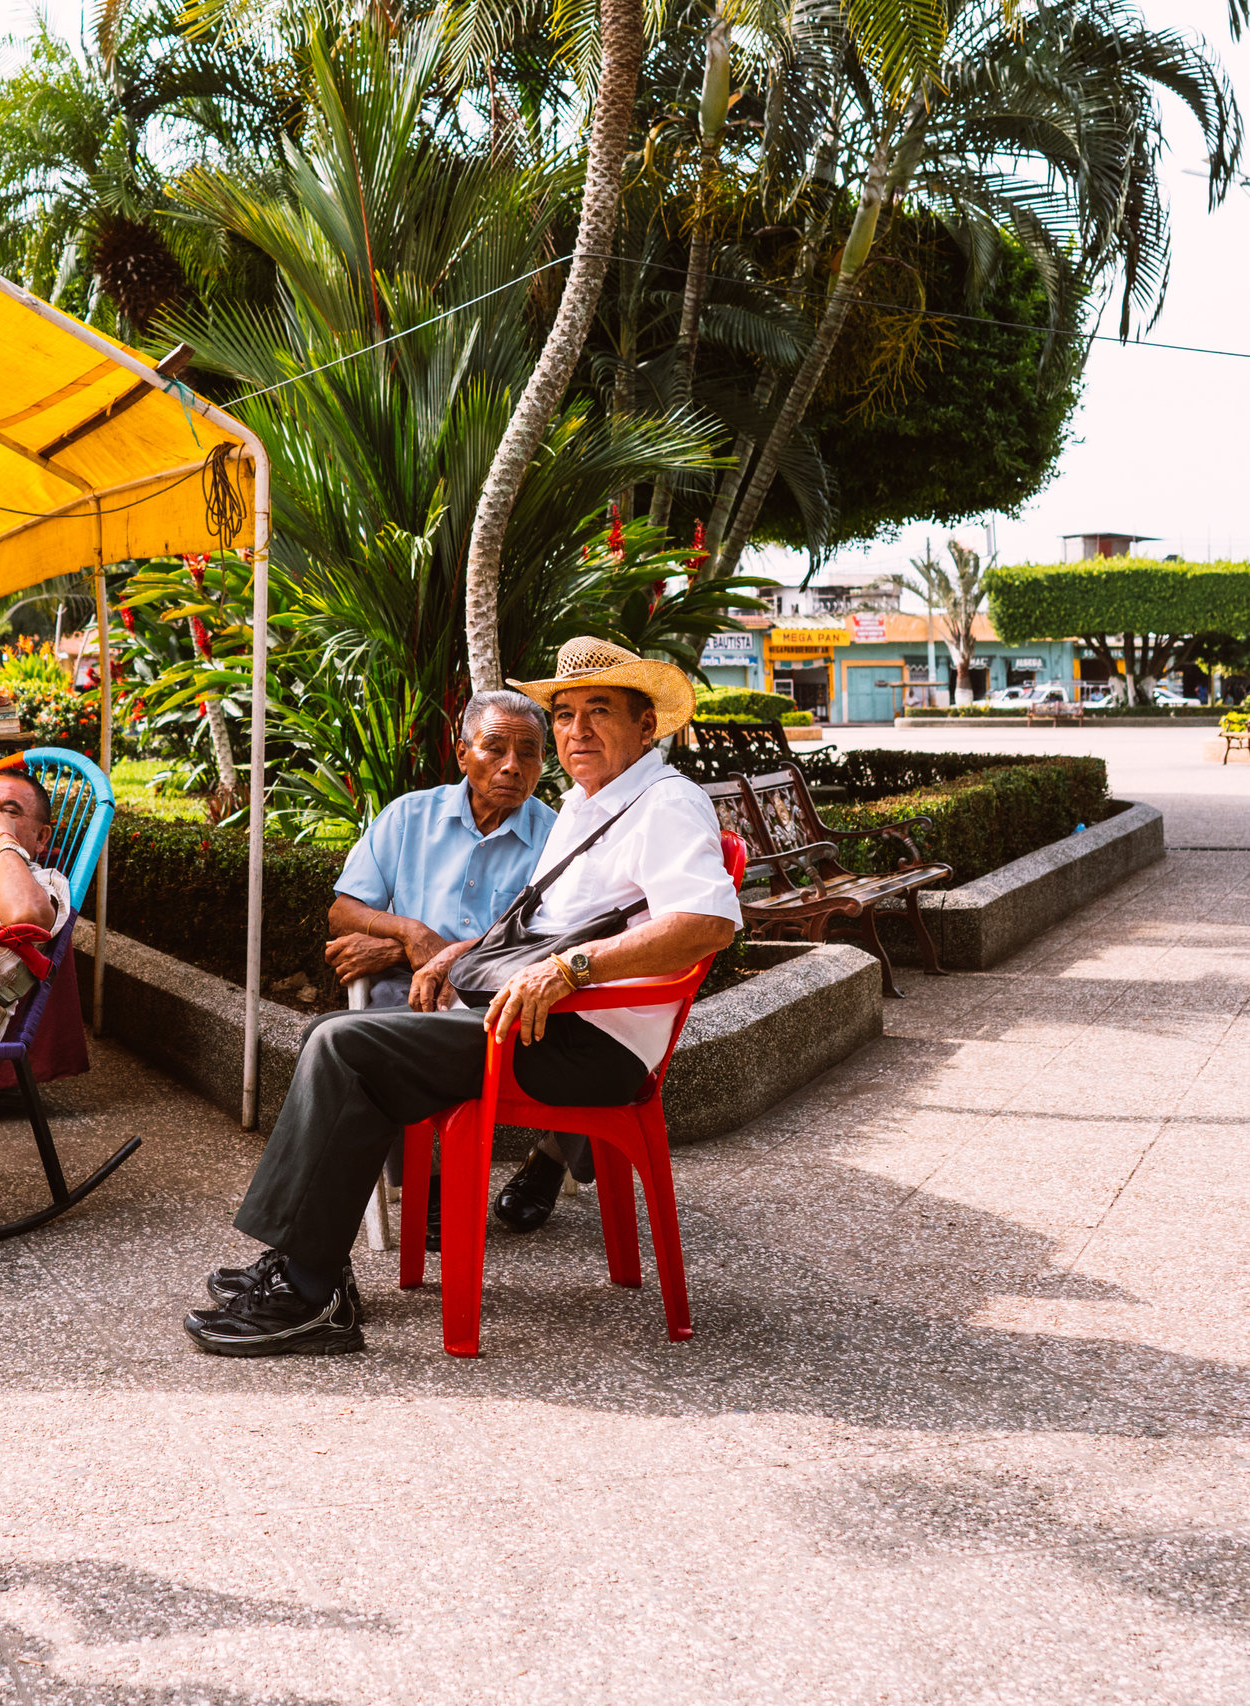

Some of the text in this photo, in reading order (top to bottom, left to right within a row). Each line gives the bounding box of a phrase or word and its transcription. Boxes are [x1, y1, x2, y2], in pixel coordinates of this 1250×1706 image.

[713, 636, 750, 648] BAUTISTA
[783, 633, 840, 642] MEGA PAN
